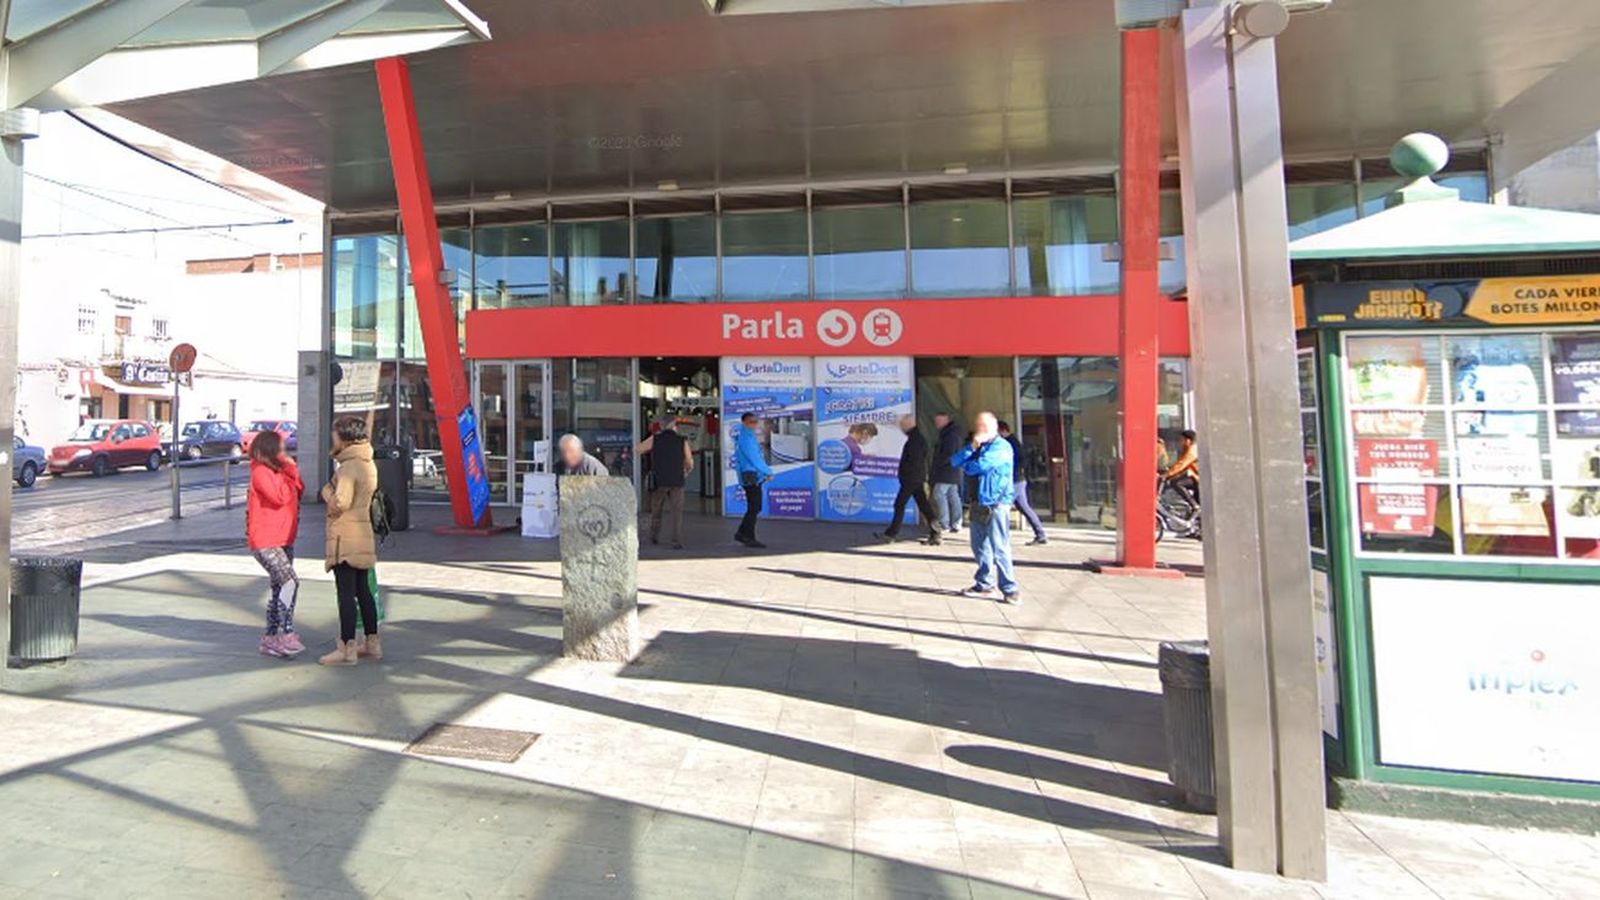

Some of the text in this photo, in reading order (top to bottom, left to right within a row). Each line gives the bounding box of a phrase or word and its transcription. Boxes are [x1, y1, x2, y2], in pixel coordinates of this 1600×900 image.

[1515, 286, 1600, 300] CADA VIER
[1491, 303, 1538, 315] BOTES
[723, 310, 804, 339] Parla
[745, 361, 801, 374] ParlaDent
[839, 361, 899, 375] ParlaDent
